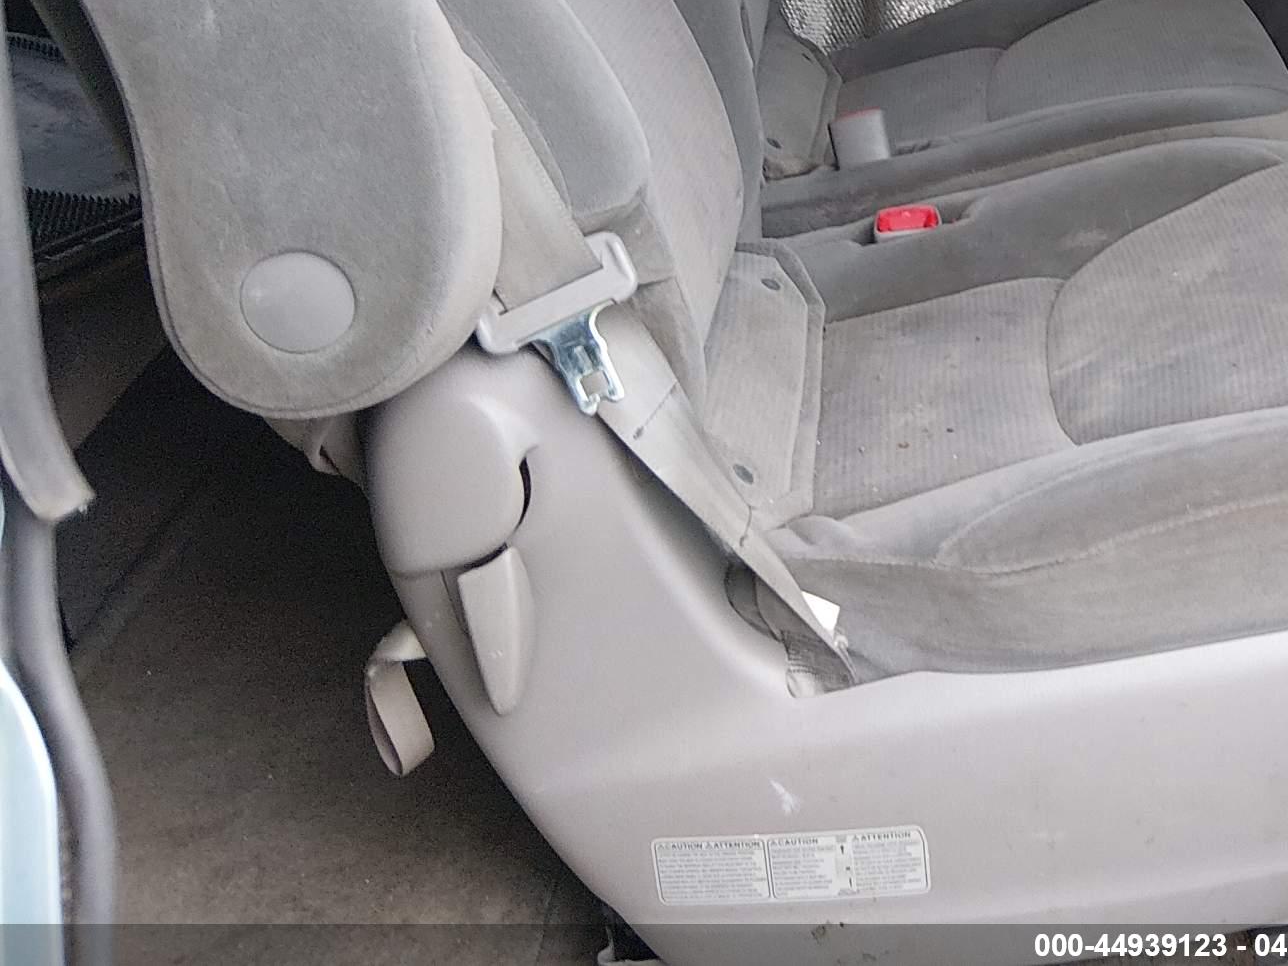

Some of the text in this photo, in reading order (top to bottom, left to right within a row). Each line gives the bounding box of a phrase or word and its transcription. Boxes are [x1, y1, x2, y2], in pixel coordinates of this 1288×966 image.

[777, 837, 818, 846] CAUTION
[861, 831, 911, 842] ATTENTION
[665, 840, 760, 850] CAUTION ATTENTION
